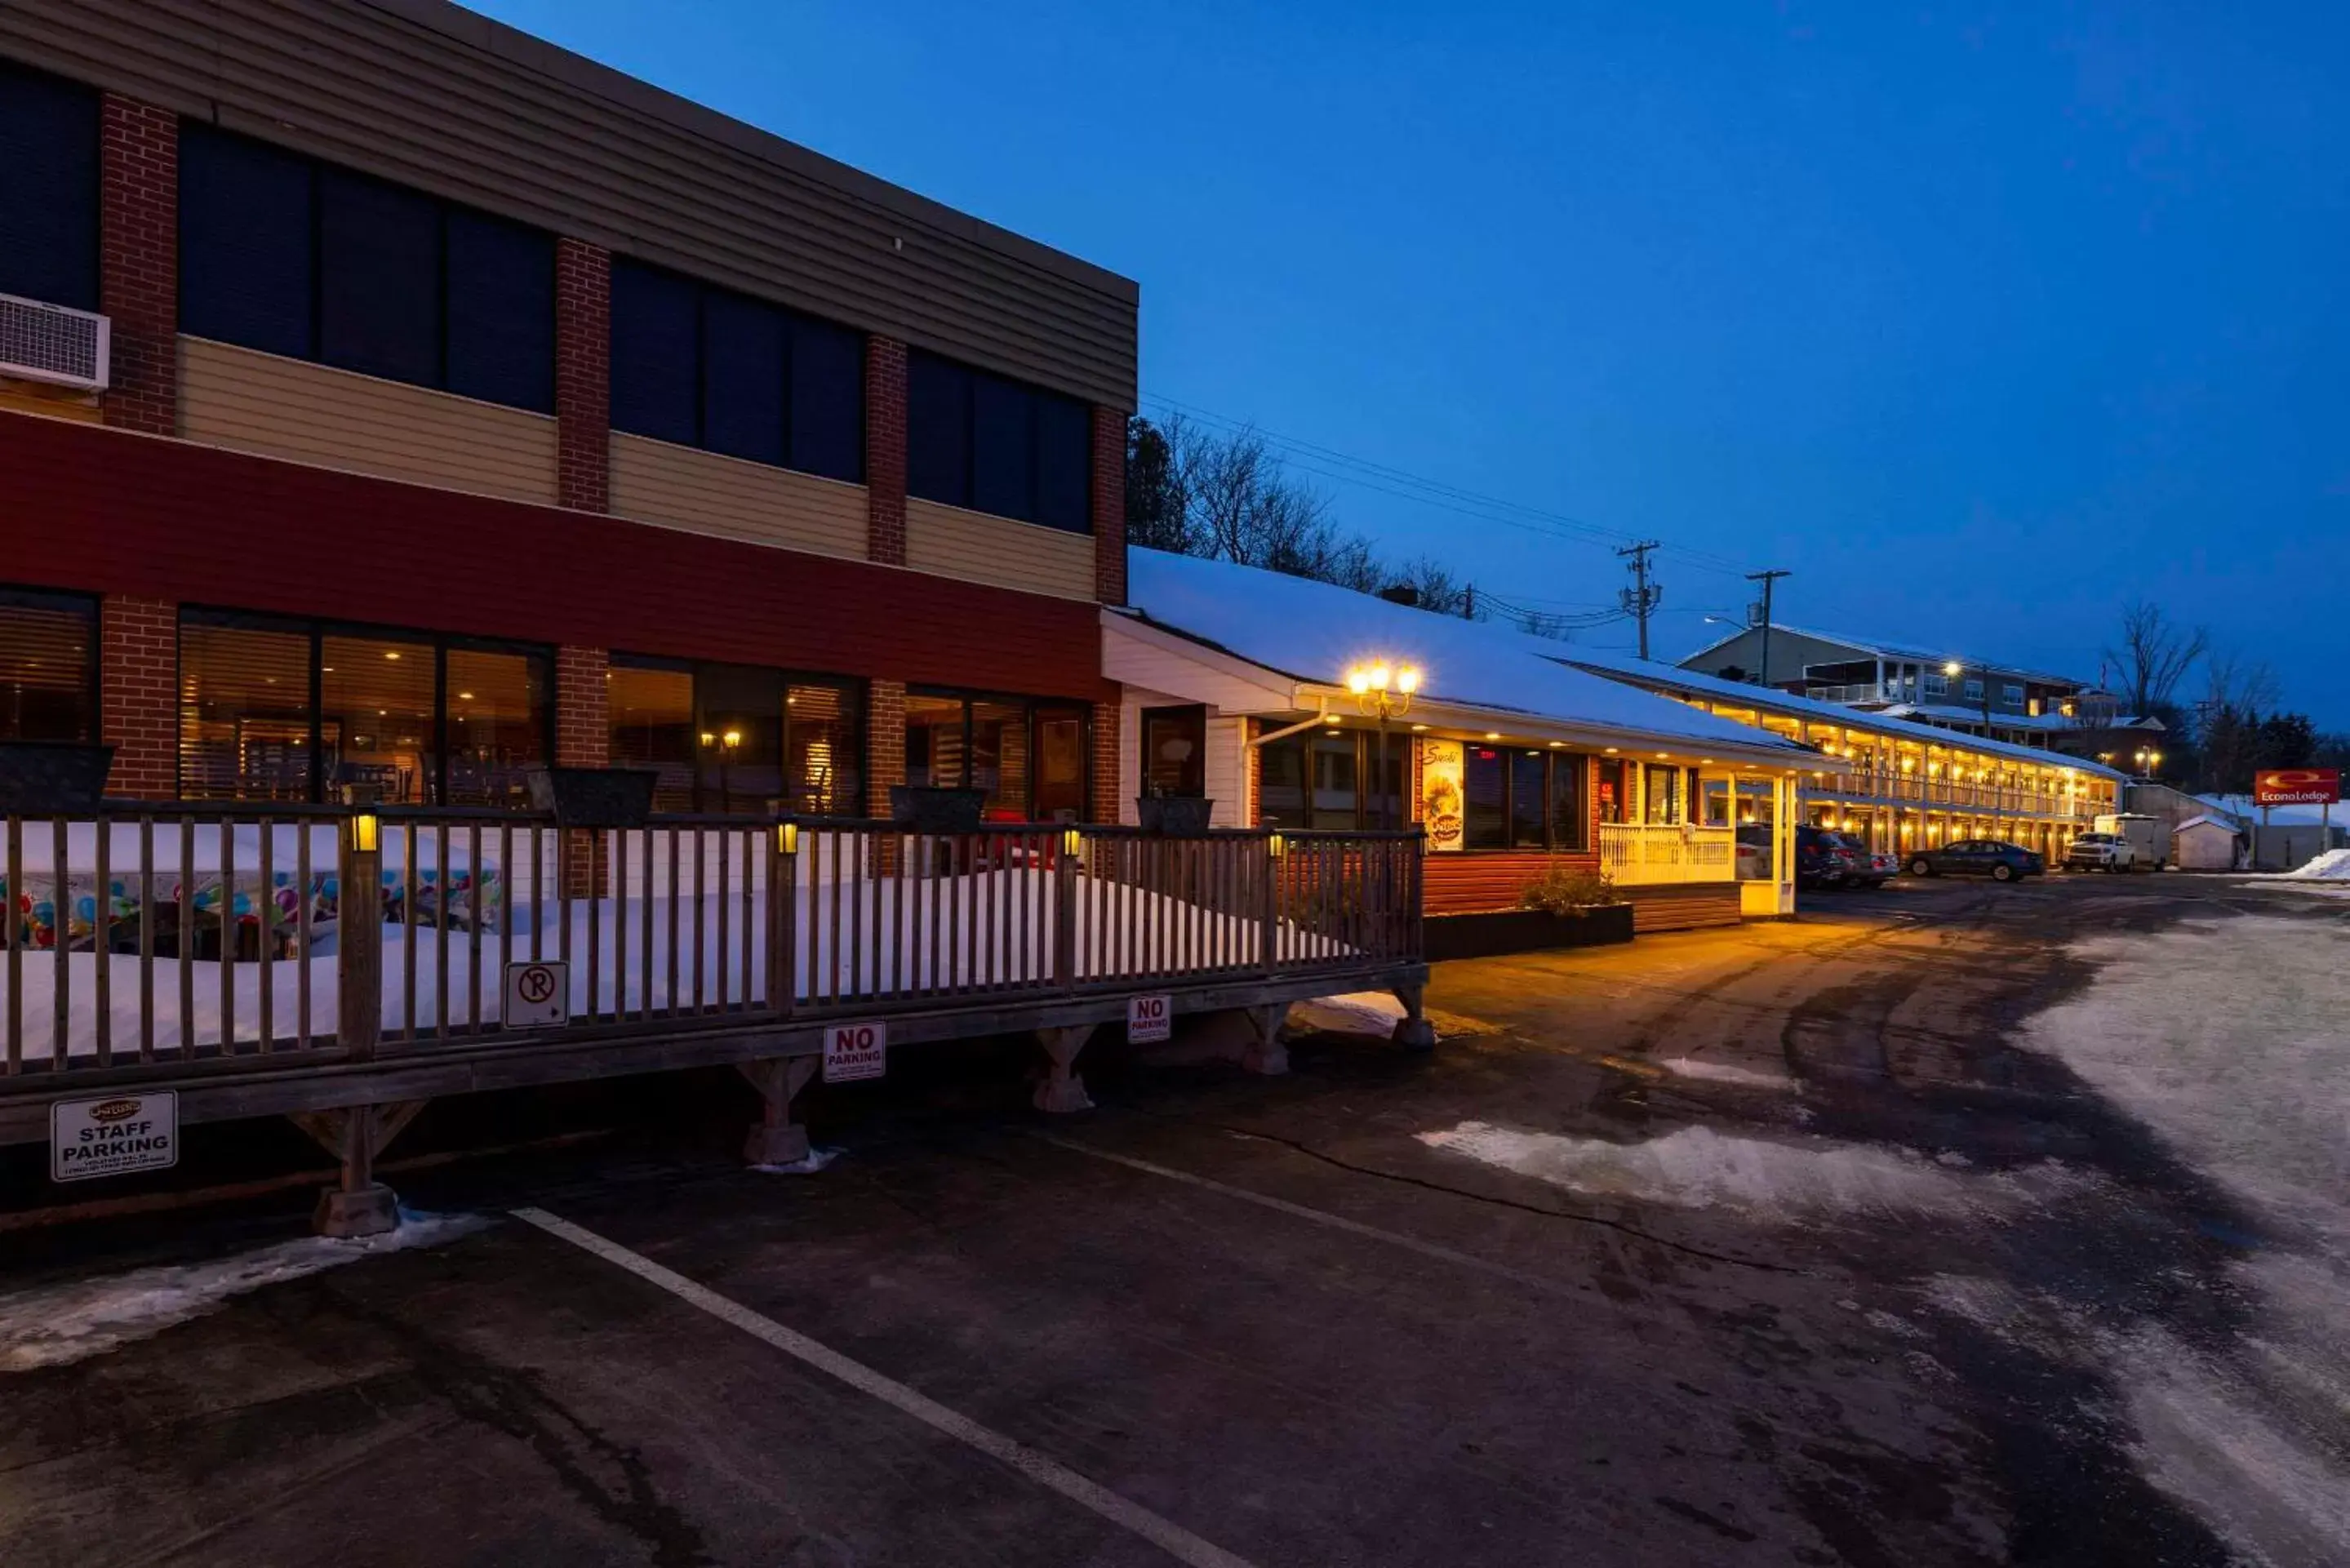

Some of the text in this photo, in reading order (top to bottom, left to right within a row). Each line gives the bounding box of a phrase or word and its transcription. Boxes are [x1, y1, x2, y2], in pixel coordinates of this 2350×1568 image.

[1137, 999, 1163, 1019] NO
[836, 1027, 875, 1053] NO
[828, 1051, 881, 1066] PARKING
[78, 1121, 153, 1142] STAFF
[63, 1135, 169, 1162] PARKING
